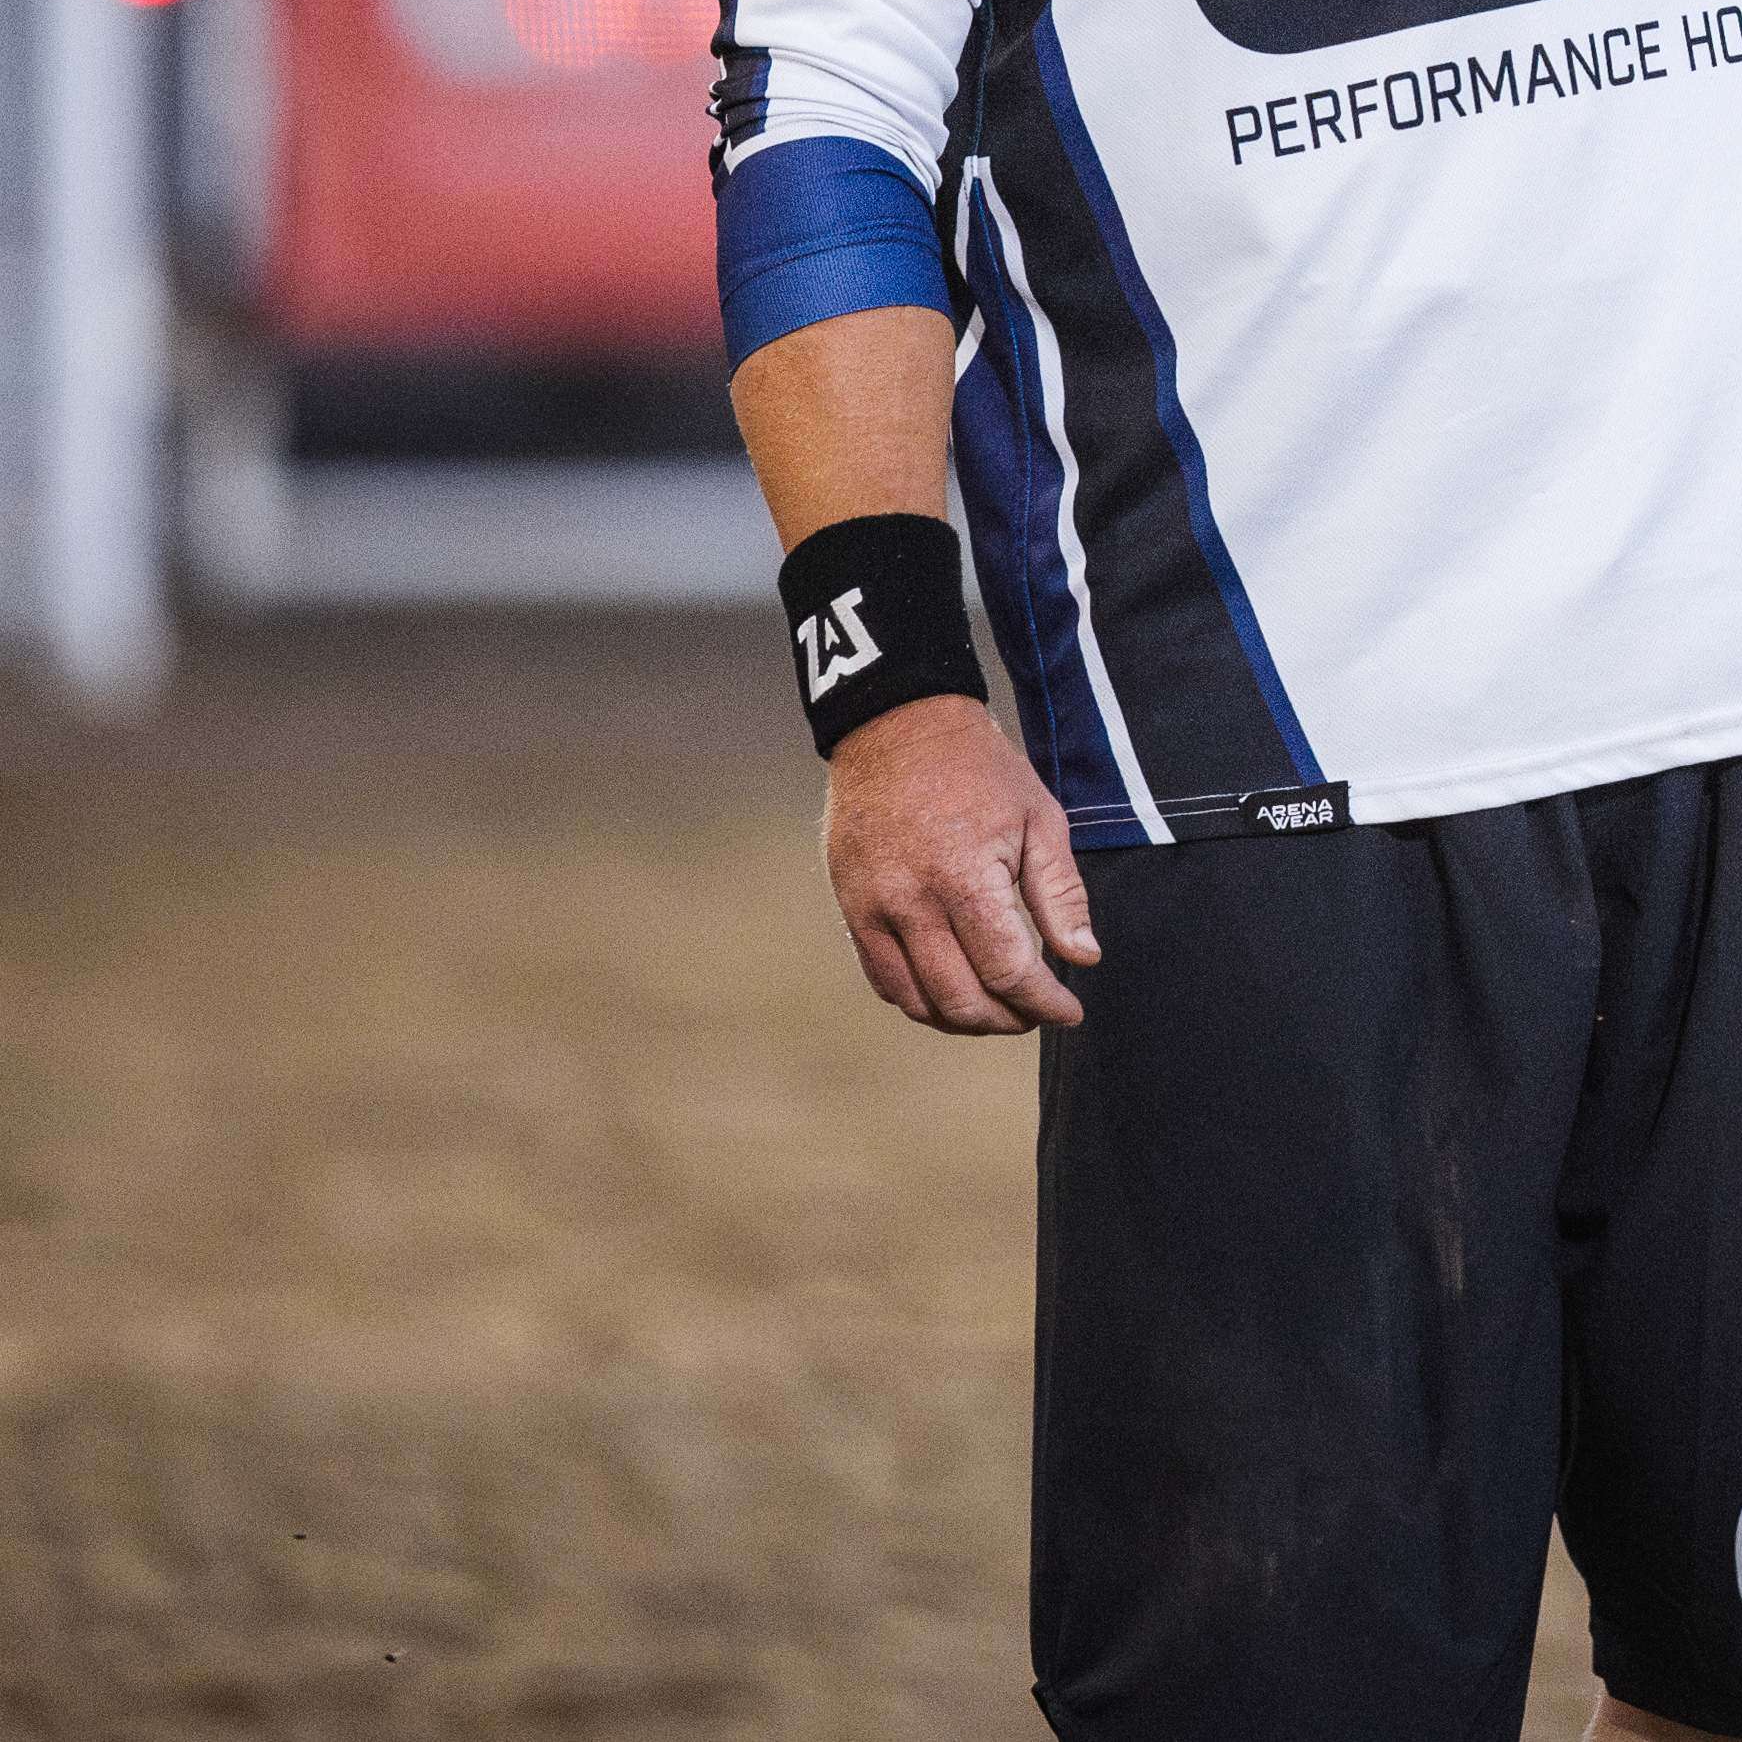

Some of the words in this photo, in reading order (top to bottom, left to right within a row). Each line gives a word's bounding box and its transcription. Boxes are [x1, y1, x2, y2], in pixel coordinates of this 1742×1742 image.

[1226, 21, 1667, 165] PERFORMANCE
[1257, 799, 1333, 820] ARENA
[1268, 811, 1334, 830] WEAR
